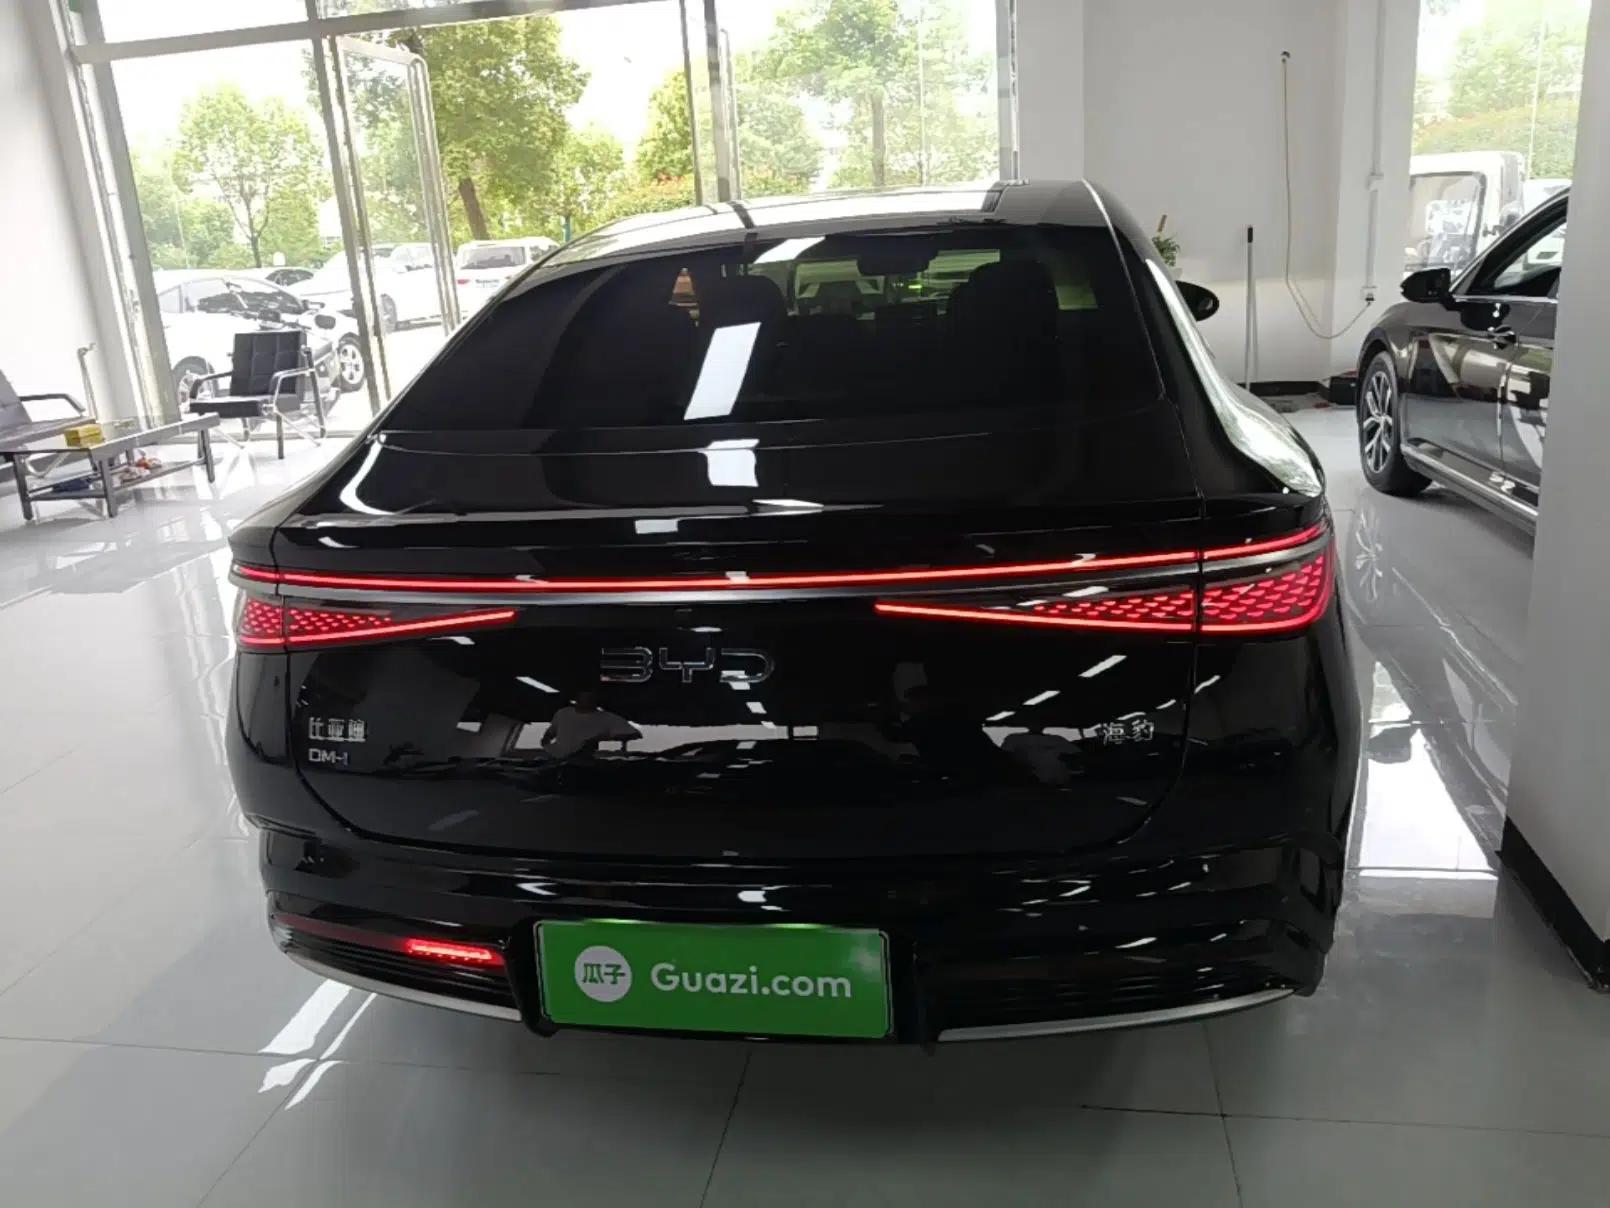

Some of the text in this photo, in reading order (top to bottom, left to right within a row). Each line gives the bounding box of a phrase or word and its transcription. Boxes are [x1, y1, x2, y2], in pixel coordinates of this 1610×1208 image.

[599, 646, 775, 683] BYD
[582, 962, 627, 985] 瓜子
[651, 962, 852, 998] Guazi.com
